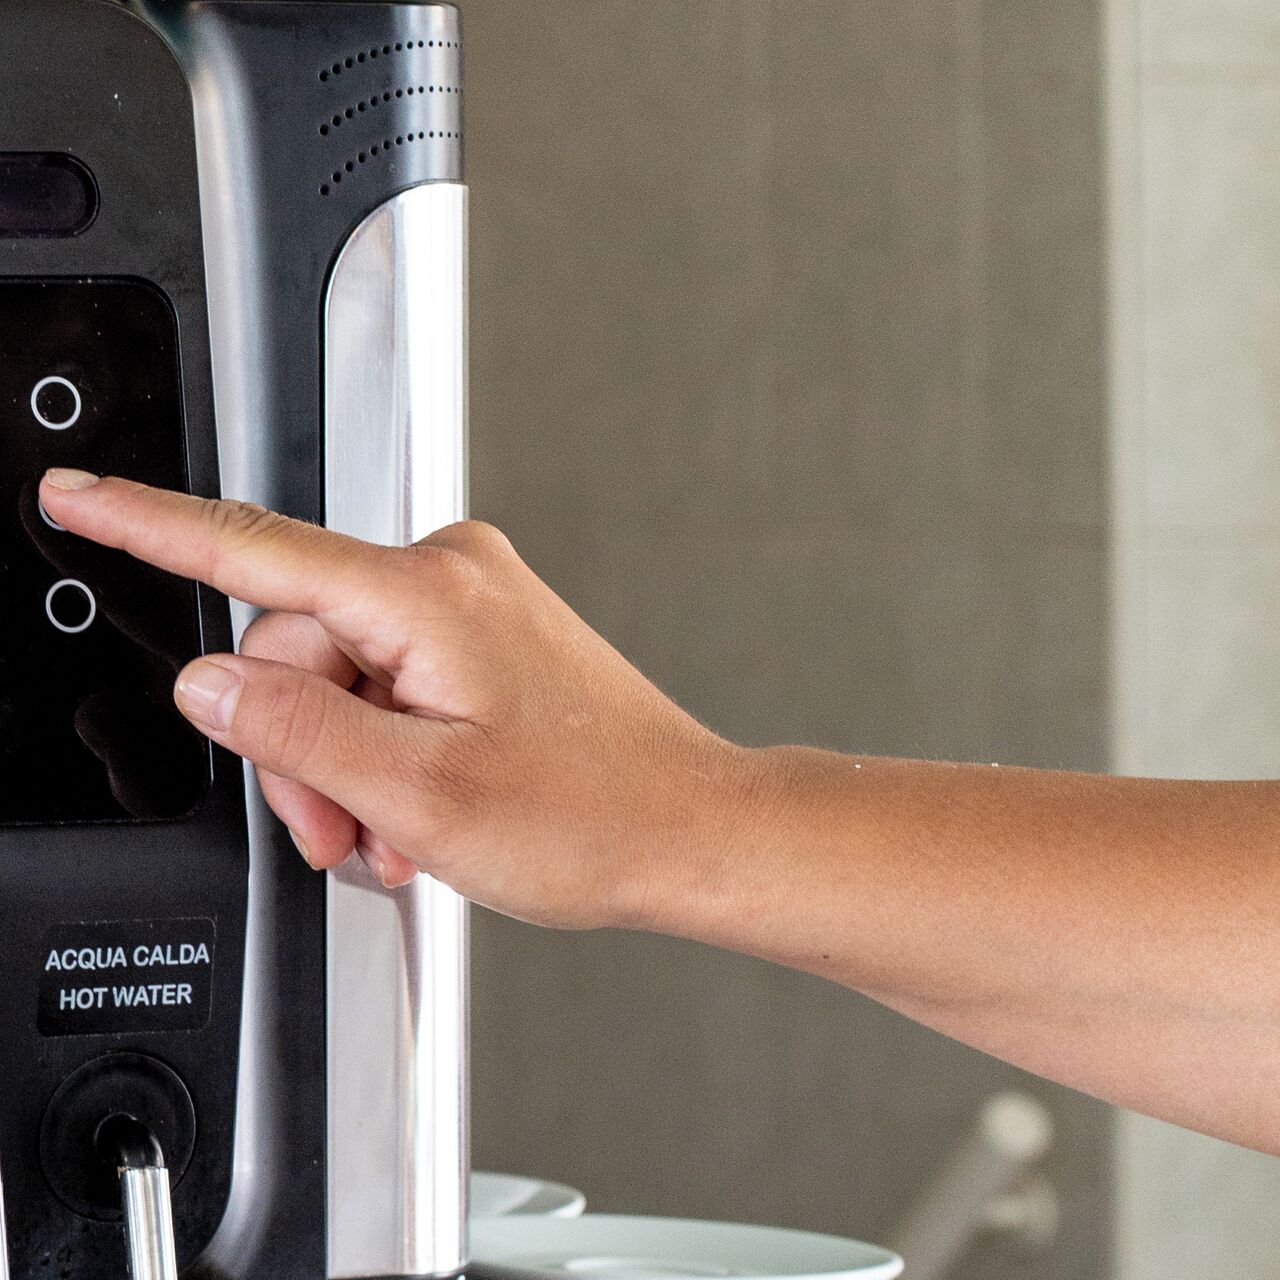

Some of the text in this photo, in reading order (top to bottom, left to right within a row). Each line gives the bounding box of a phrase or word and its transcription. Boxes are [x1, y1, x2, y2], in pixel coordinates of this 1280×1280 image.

[45, 942, 210, 972] ACQUA CALDA
[59, 983, 193, 1011] HOT WATER
